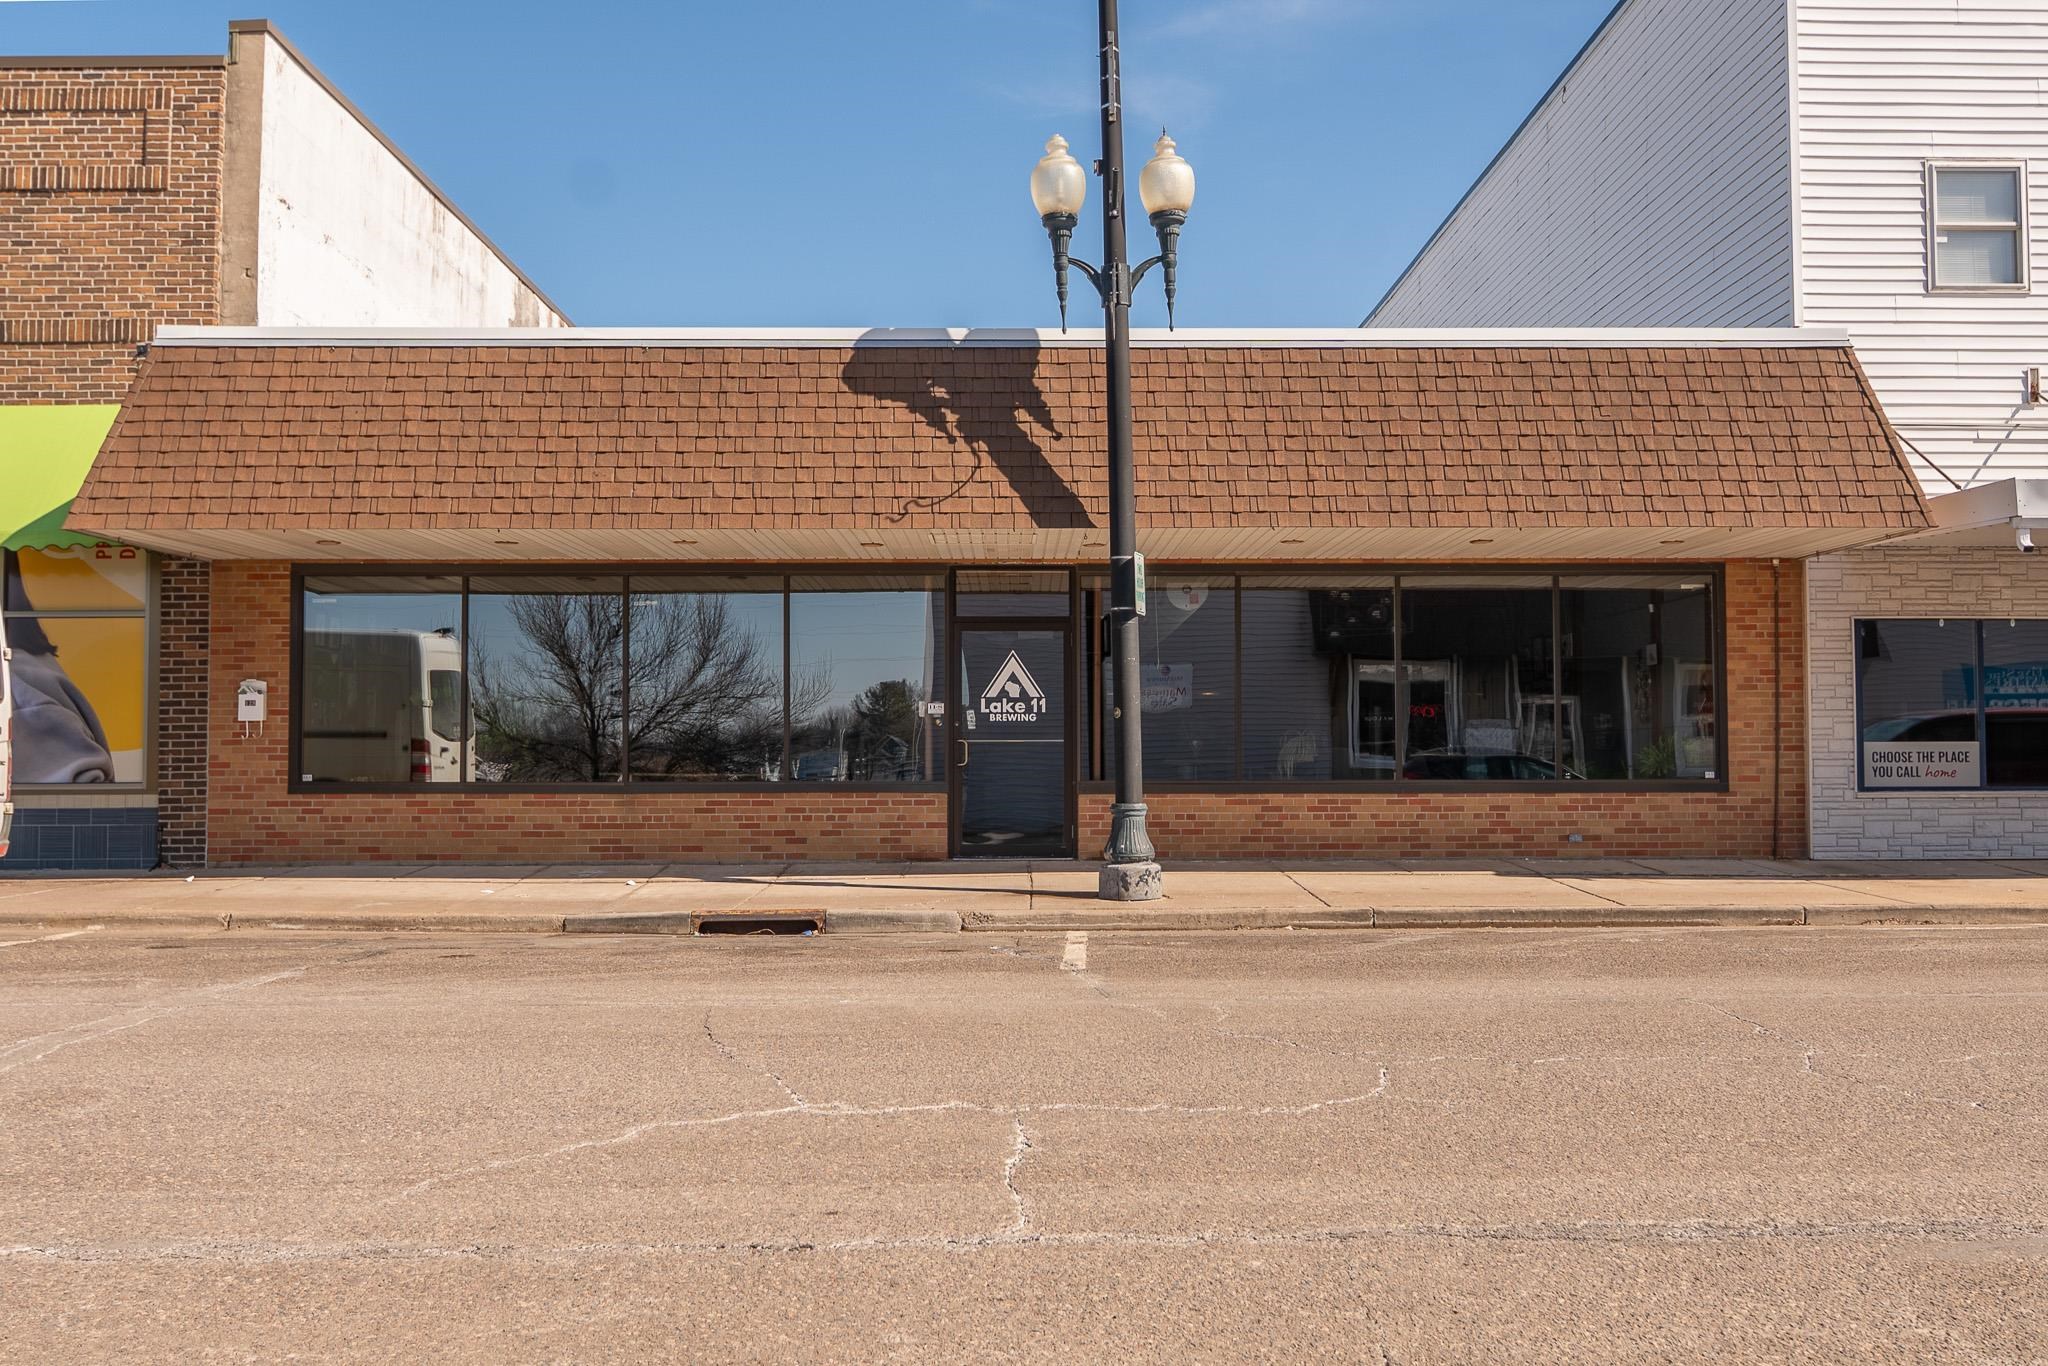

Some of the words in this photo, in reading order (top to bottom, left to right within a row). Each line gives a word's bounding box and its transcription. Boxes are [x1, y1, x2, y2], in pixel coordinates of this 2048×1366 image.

[980, 698, 1026, 713] Lake
[1031, 698, 1046, 713] 11
[989, 713, 1037, 722] BREWING
[1871, 751, 1913, 763] CHOOSE
[1915, 751, 1935, 763] THE
[1938, 751, 1970, 763] PLACE
[1871, 766, 1893, 778] YOU
[1896, 766, 1921, 778] CALL
[1924, 765, 1957, 778] home
